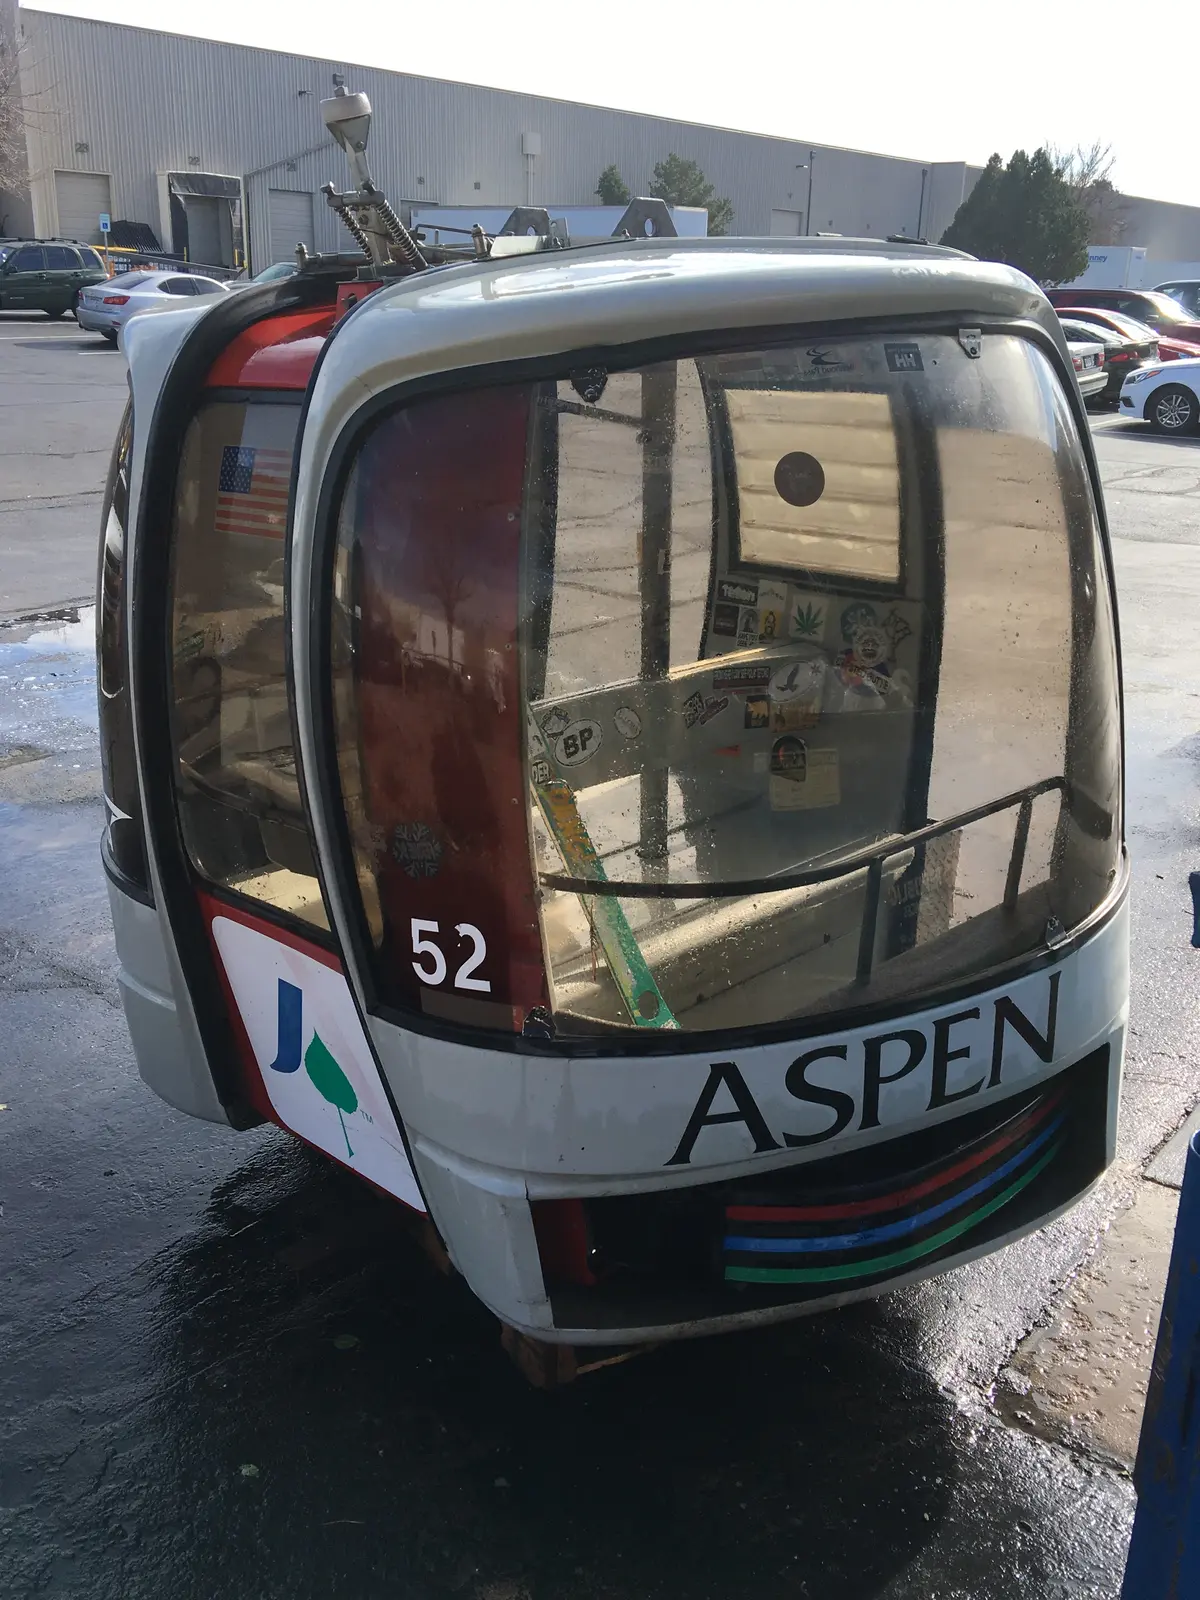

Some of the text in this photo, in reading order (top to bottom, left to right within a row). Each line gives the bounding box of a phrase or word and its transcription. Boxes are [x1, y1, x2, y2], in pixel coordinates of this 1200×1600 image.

[1088, 254, 1108, 263] nney
[563, 726, 594, 760] BP
[410, 917, 491, 993] 52
[662, 970, 1062, 1167] ASPEN
